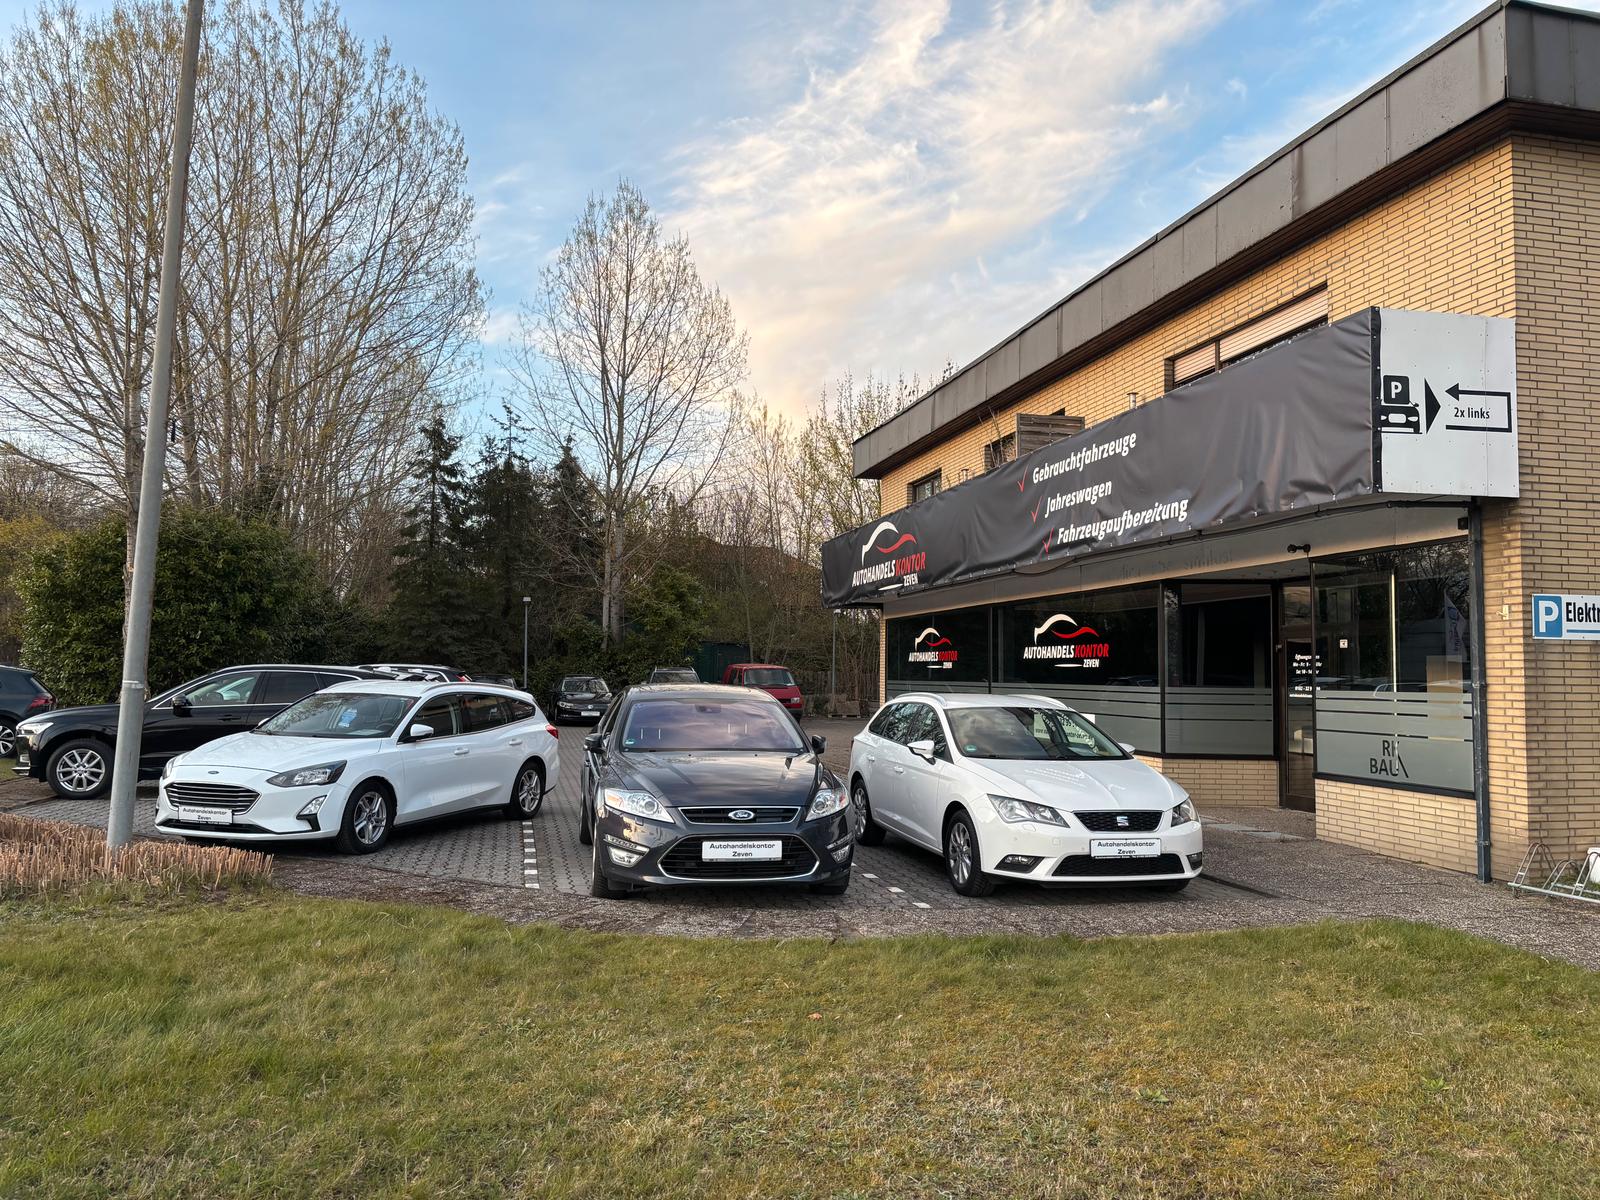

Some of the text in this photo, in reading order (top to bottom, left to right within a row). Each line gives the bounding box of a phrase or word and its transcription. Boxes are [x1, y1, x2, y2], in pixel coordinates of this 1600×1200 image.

[1390, 381, 1402, 399] P
[1453, 407, 1490, 419] 2x links
[1032, 433, 1137, 484] Gebrauchtfahrzeuge
[1045, 480, 1112, 518] Jahreswagen
[1057, 499, 1189, 544] Fahrzeugaufbereitung
[903, 573, 919, 586] ZEVEN
[1538, 600, 1559, 633] P
[1083, 659, 1100, 668] ZEVEN
[1369, 757, 1399, 777] BAU
[182, 808, 228, 816] Autohandelskontor
